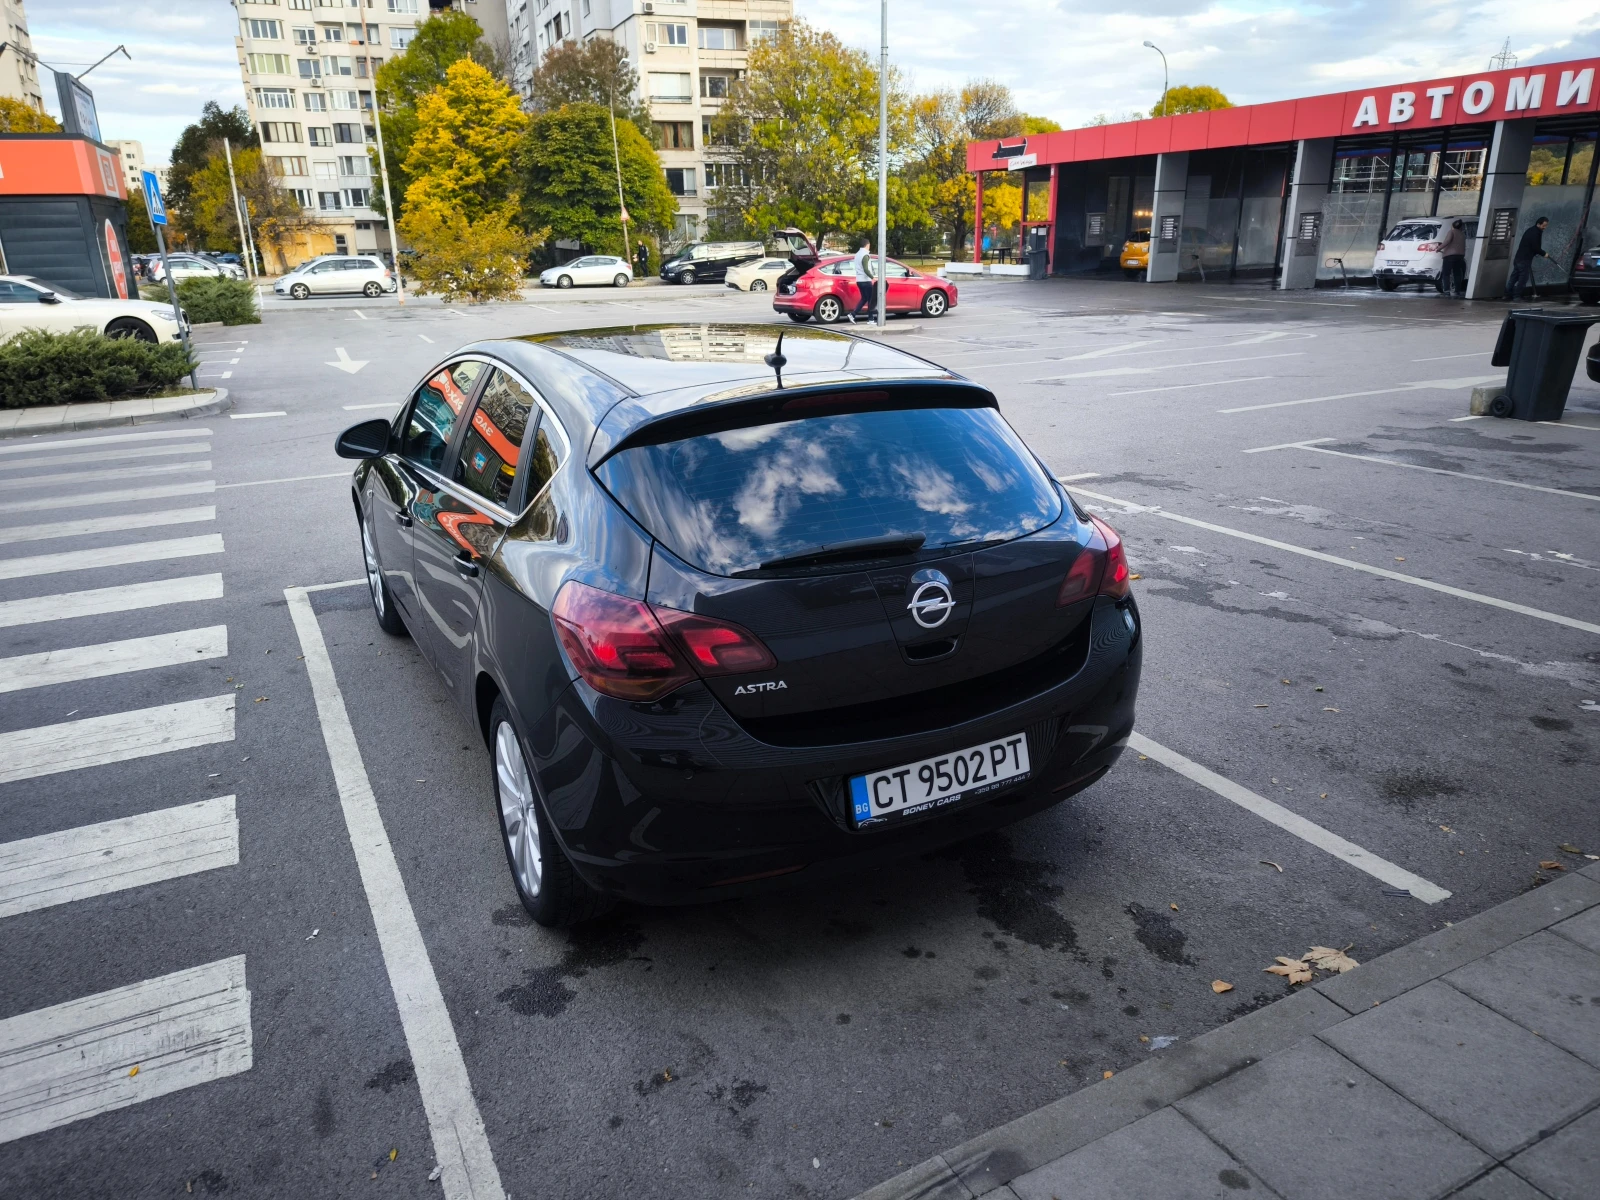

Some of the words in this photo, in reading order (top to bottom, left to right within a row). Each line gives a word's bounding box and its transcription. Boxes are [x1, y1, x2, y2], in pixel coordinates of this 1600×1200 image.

[1352, 68, 1596, 128] АВТОМИ
[734, 680, 788, 696] ASTRA
[873, 769, 910, 809] CT
[918, 751, 987, 797] 9502
[989, 738, 1022, 777] PT
[855, 802, 869, 815] BG
[903, 801, 935, 816] BONEV
[937, 794, 961, 806] CARS
